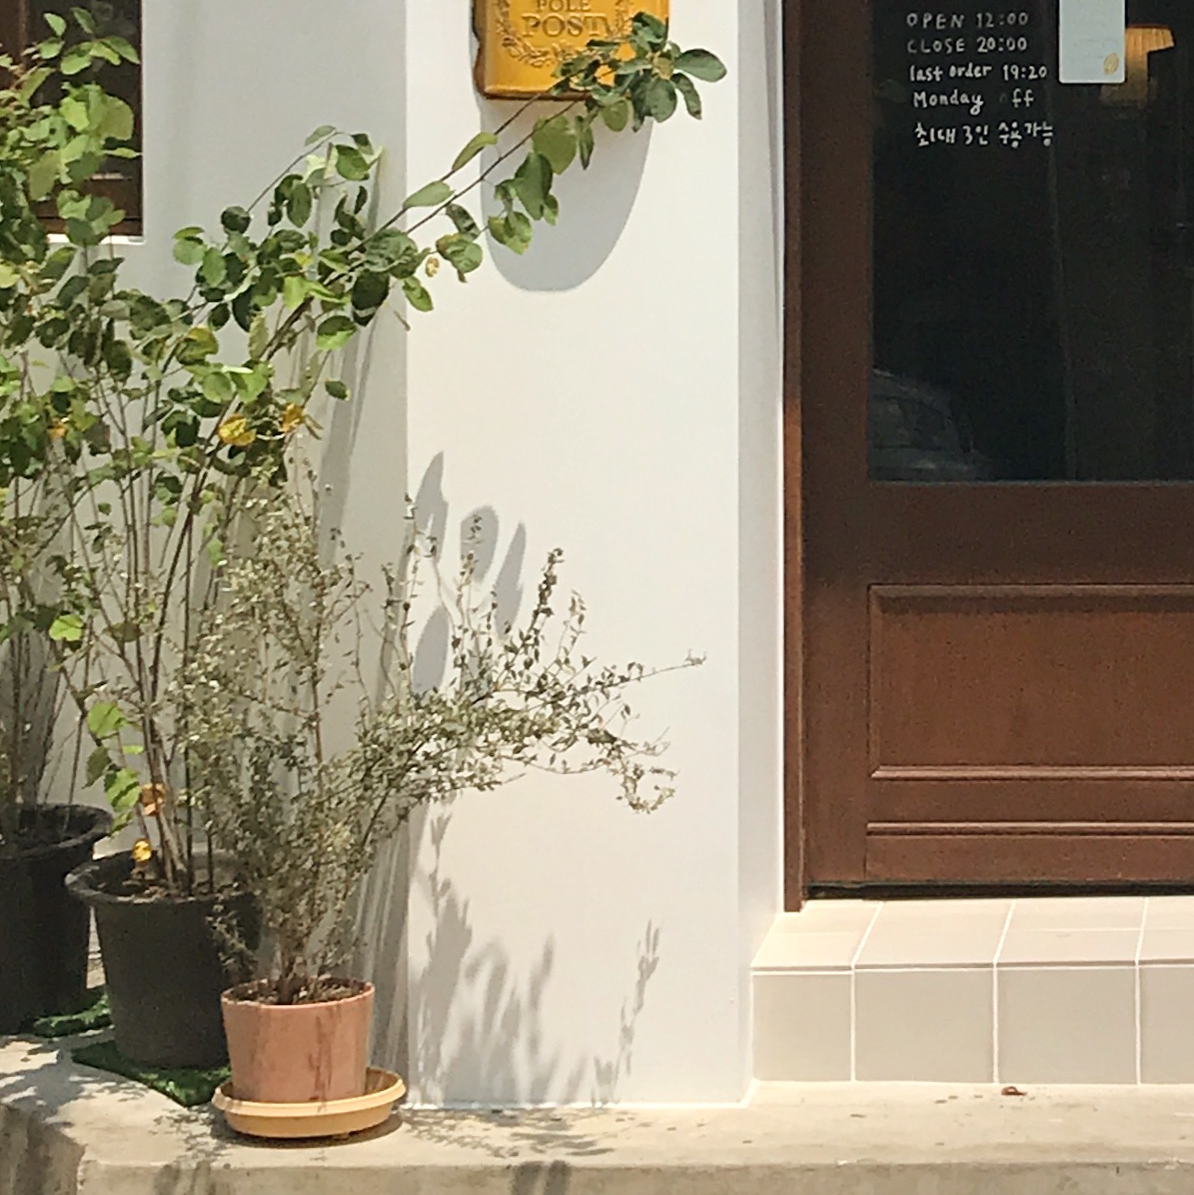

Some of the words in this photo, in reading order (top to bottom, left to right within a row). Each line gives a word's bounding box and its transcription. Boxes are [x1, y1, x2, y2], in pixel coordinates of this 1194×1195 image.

[520, 13, 608, 38] POST
[906, 12, 965, 30] OPEN
[976, 12, 1029, 29] 12:00
[907, 37, 965, 54] CLOSE
[976, 37, 1028, 53] 20:00
[909, 64, 944, 82] last
[949, 62, 993, 78] order
[1002, 64, 1048, 81] 19:20
[913, 89, 985, 116] Monday
[914, 121, 957, 147] 최대
[962, 124, 989, 146] 3인
